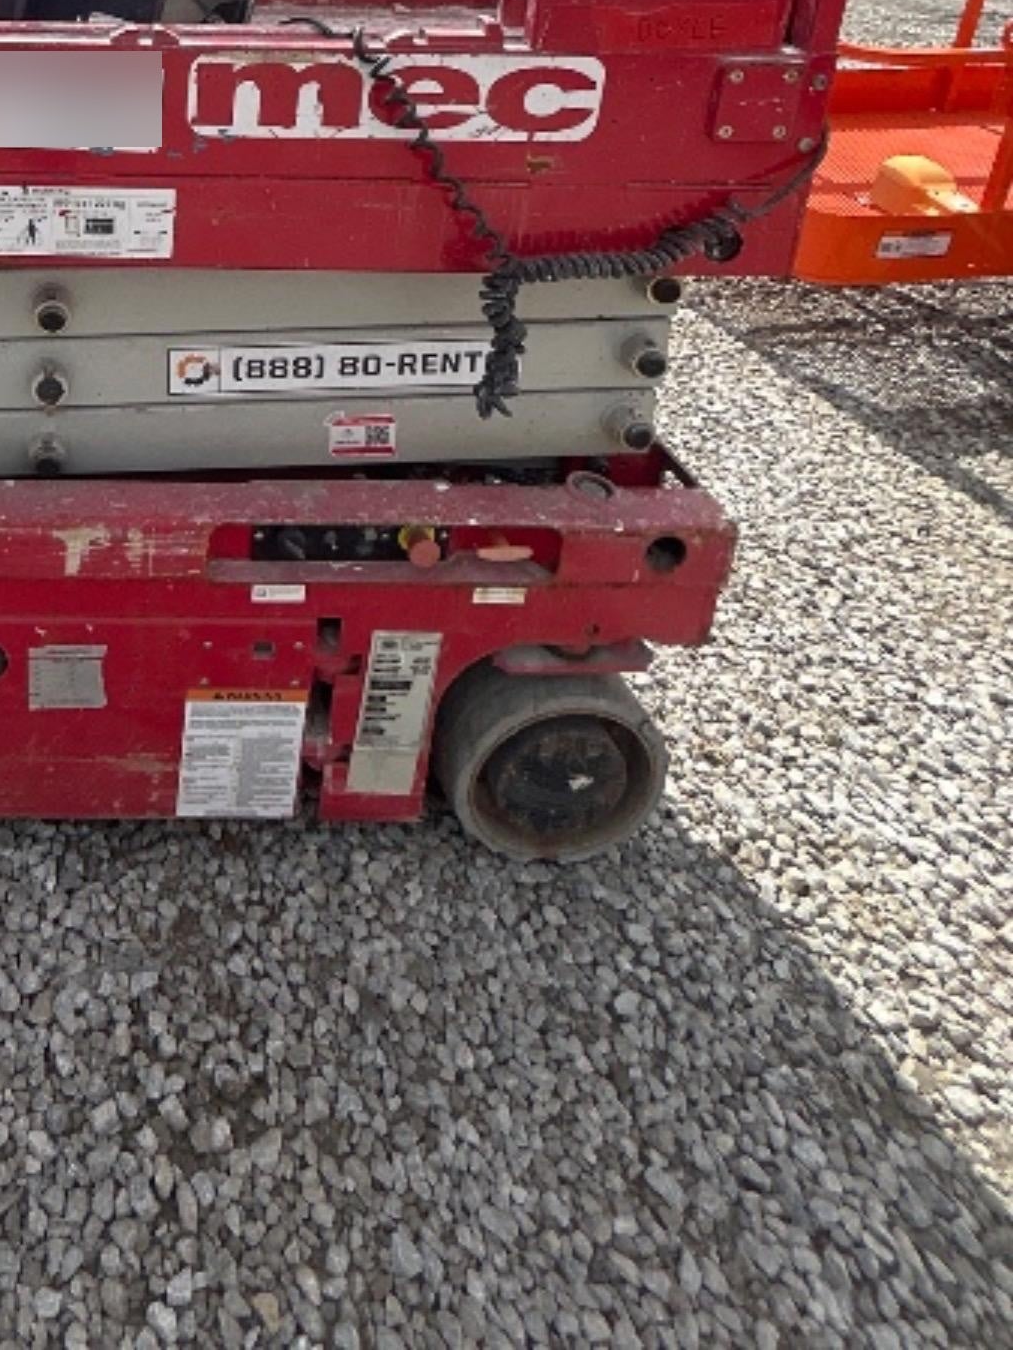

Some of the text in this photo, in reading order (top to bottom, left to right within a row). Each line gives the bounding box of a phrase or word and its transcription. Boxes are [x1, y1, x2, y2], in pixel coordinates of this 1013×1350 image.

[196, 61, 598, 133] mec
[231, 350, 510, 382] (888) 80-RENT
